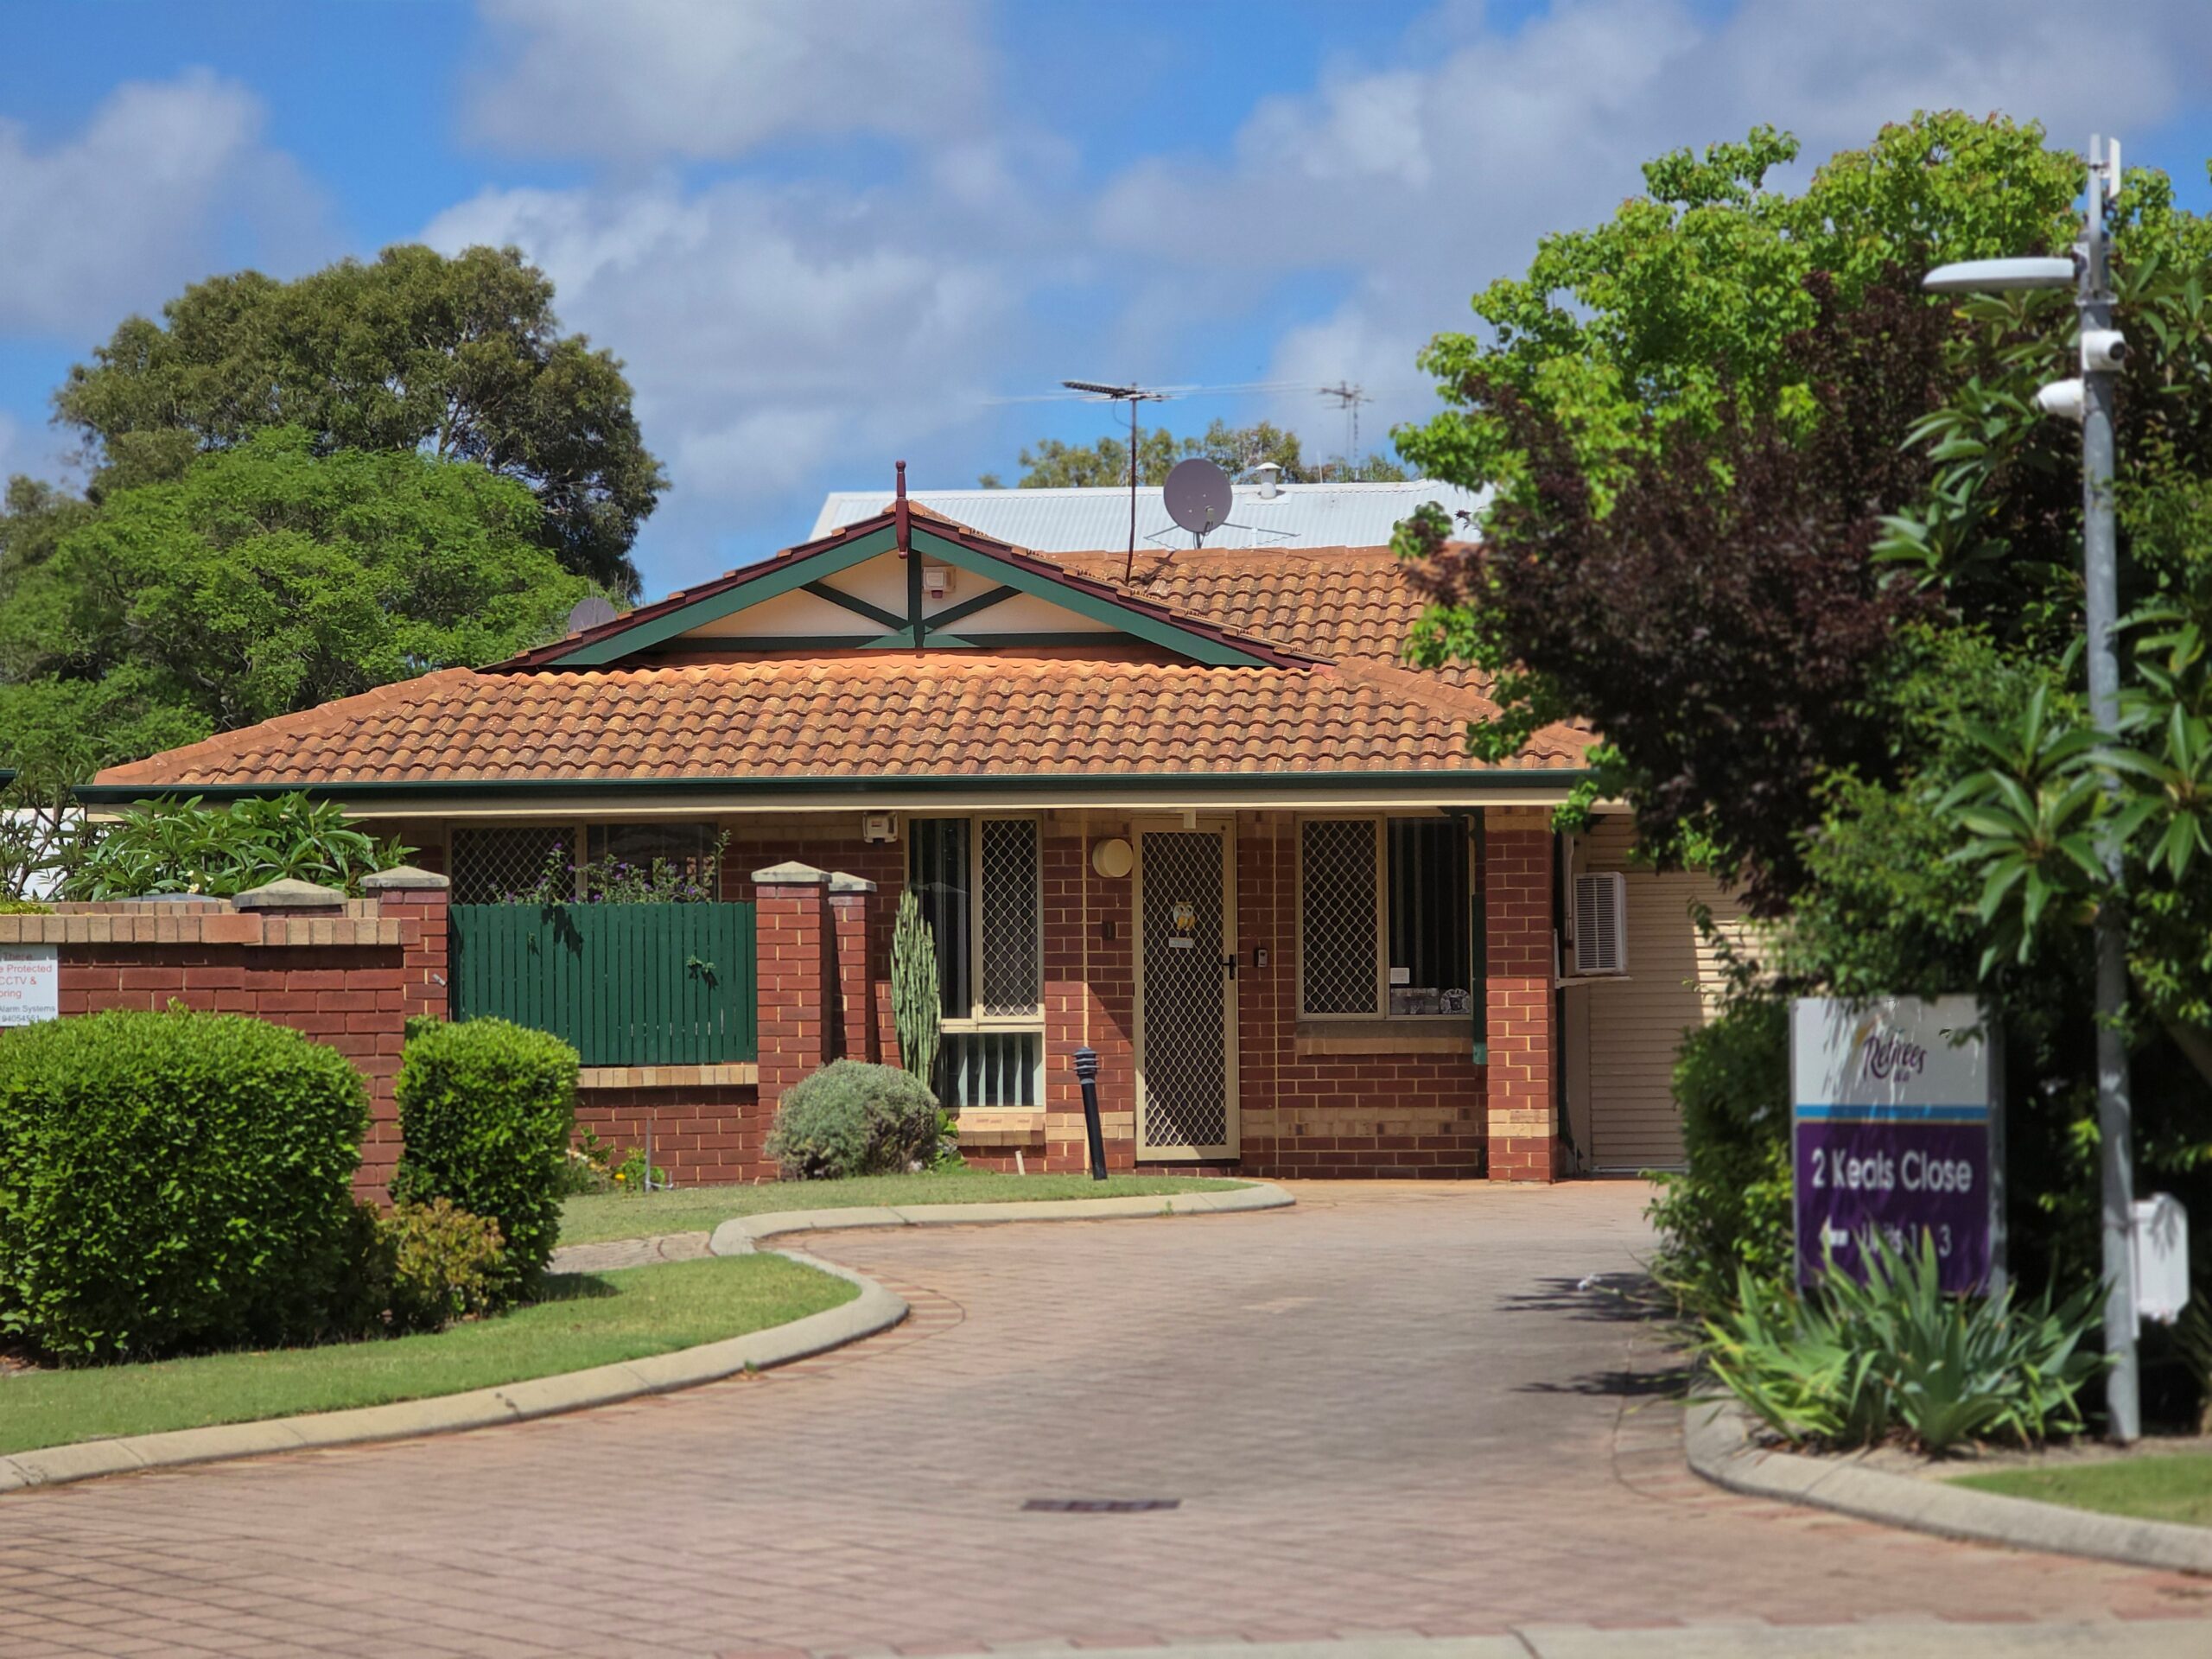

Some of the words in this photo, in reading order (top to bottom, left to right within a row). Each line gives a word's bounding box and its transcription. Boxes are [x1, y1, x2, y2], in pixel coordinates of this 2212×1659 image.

[7, 963, 52, 973] Protected
[29, 976, 36, 985] &
[22, 1004, 55, 1014] Systems
[1812, 1147, 1826, 1188] 2
[1902, 1150, 1973, 1193] Close
[1939, 1224, 1951, 1256] 3
